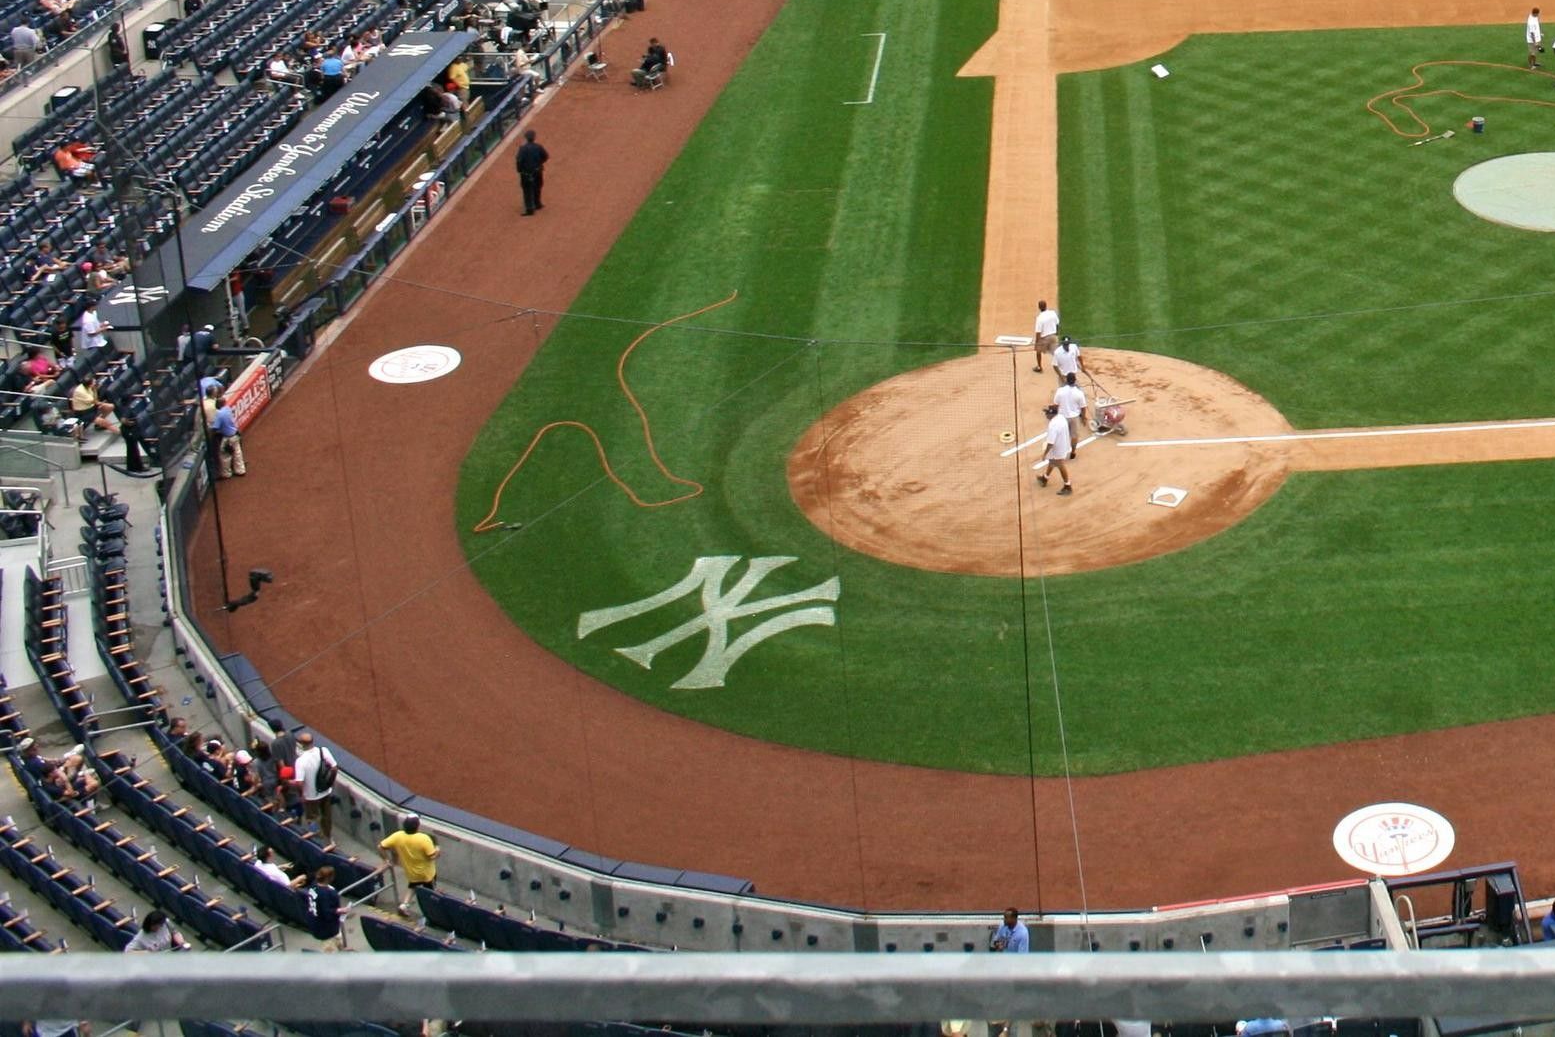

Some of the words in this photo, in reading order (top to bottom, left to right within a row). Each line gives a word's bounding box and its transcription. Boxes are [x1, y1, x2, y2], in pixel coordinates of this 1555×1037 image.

[314, 91, 380, 133] Welcome
[302, 131, 329, 145] to
[258, 143, 325, 183] Yankee
[201, 183, 274, 233] Stadium
[577, 555, 841, 689] NY
